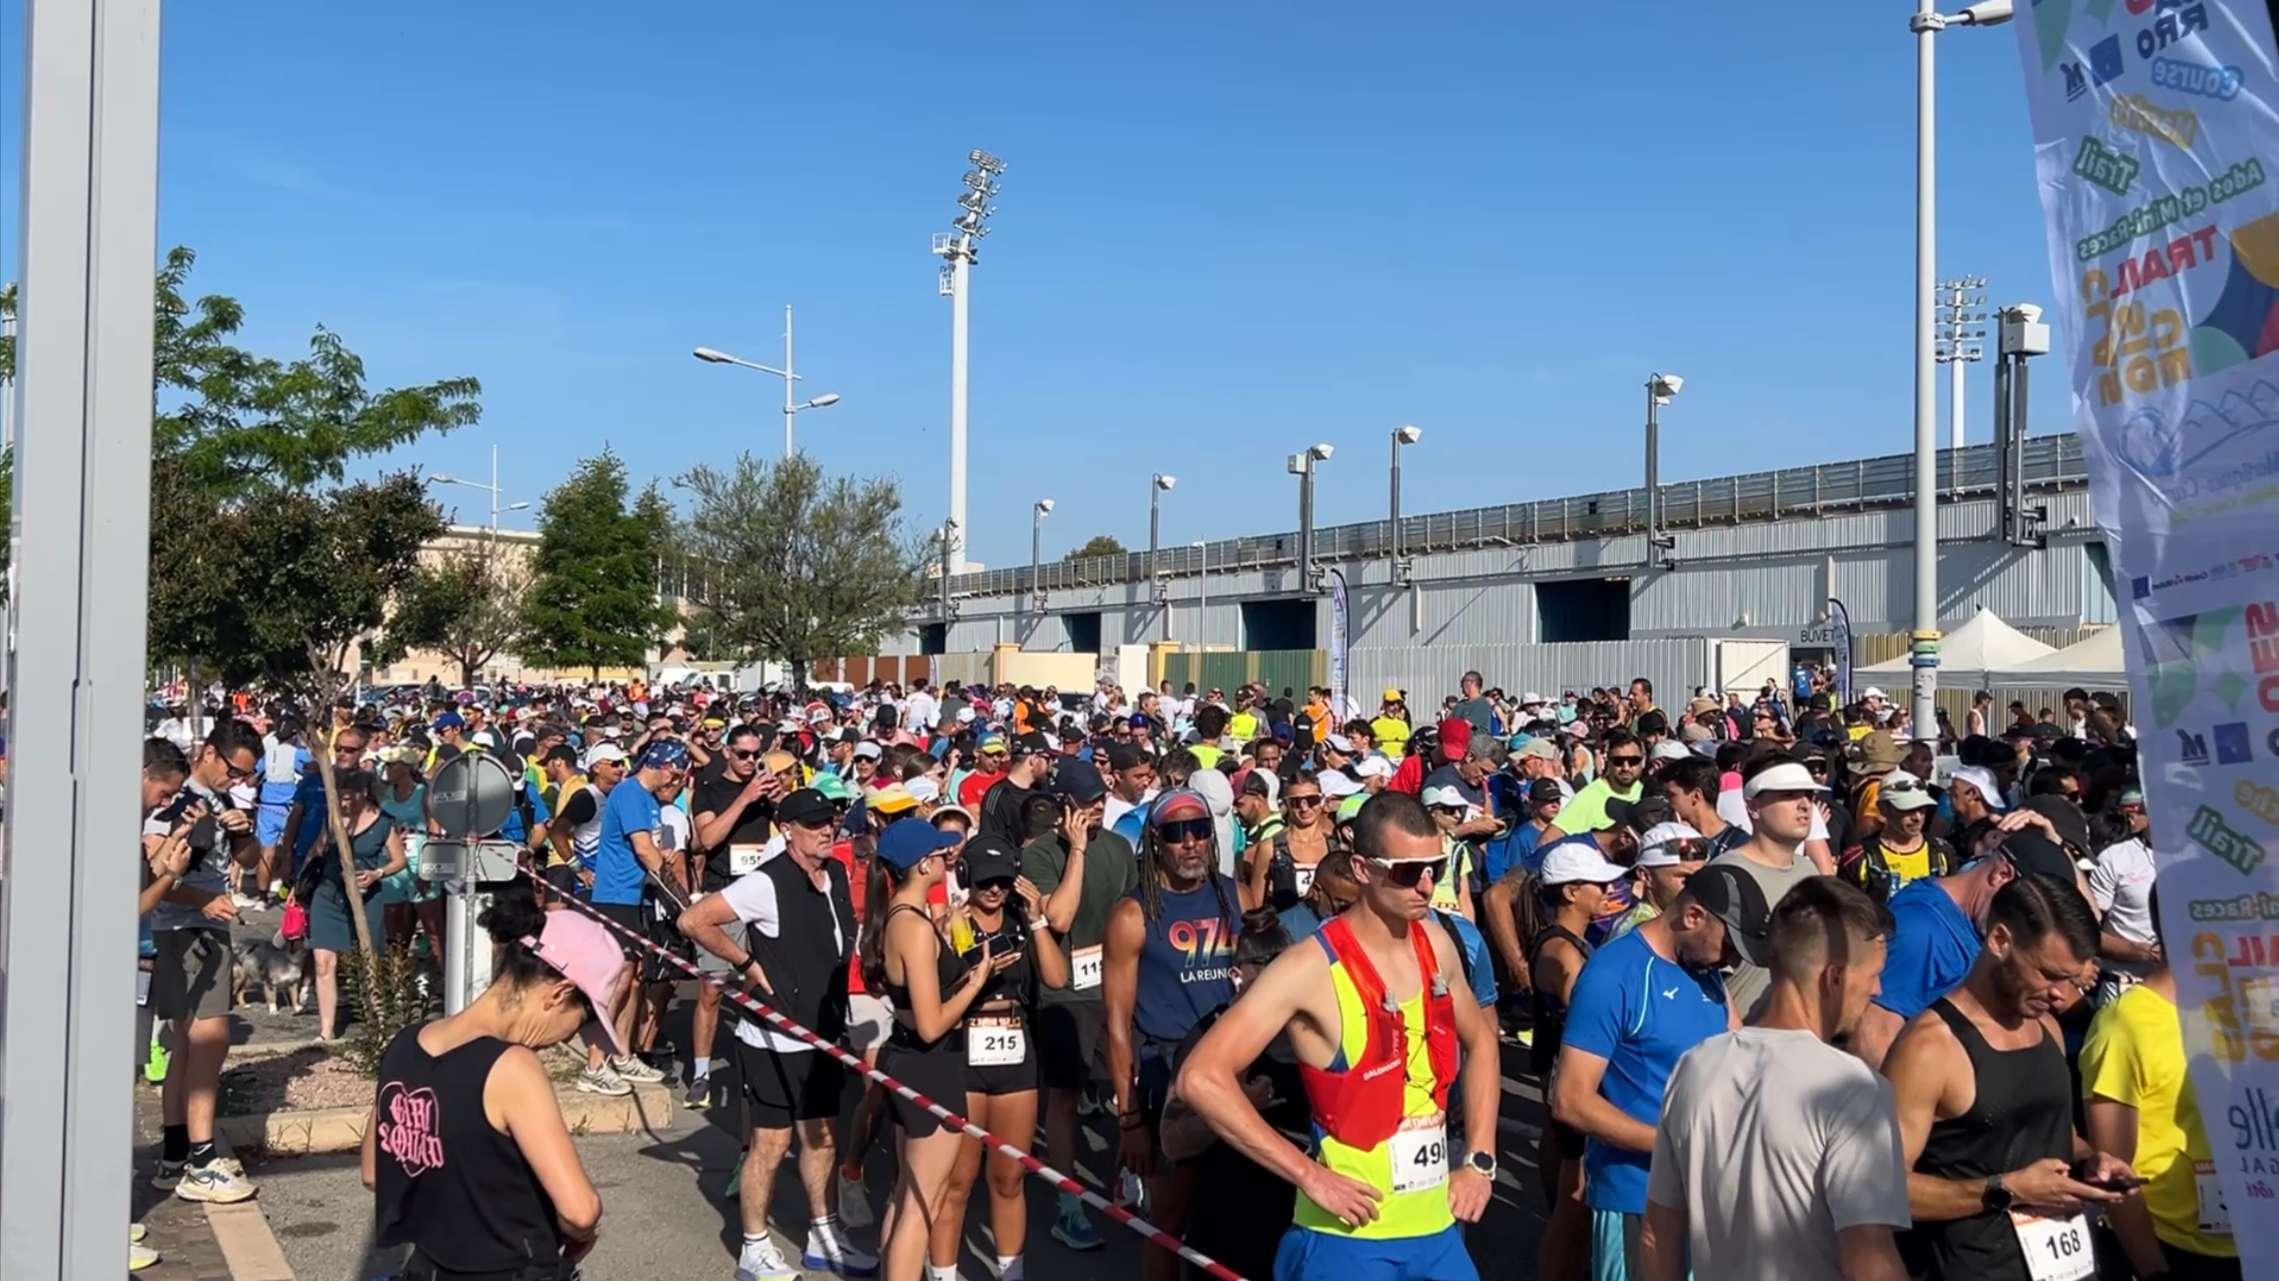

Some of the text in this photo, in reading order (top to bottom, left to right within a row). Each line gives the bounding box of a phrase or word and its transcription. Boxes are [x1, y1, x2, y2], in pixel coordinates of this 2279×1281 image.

[1169, 917, 1239, 968] 974
[1081, 961, 1103, 976] 11
[1180, 971, 1196, 983] LA
[985, 1035, 1017, 1050] 215
[2046, 1228, 2081, 1260] 168
